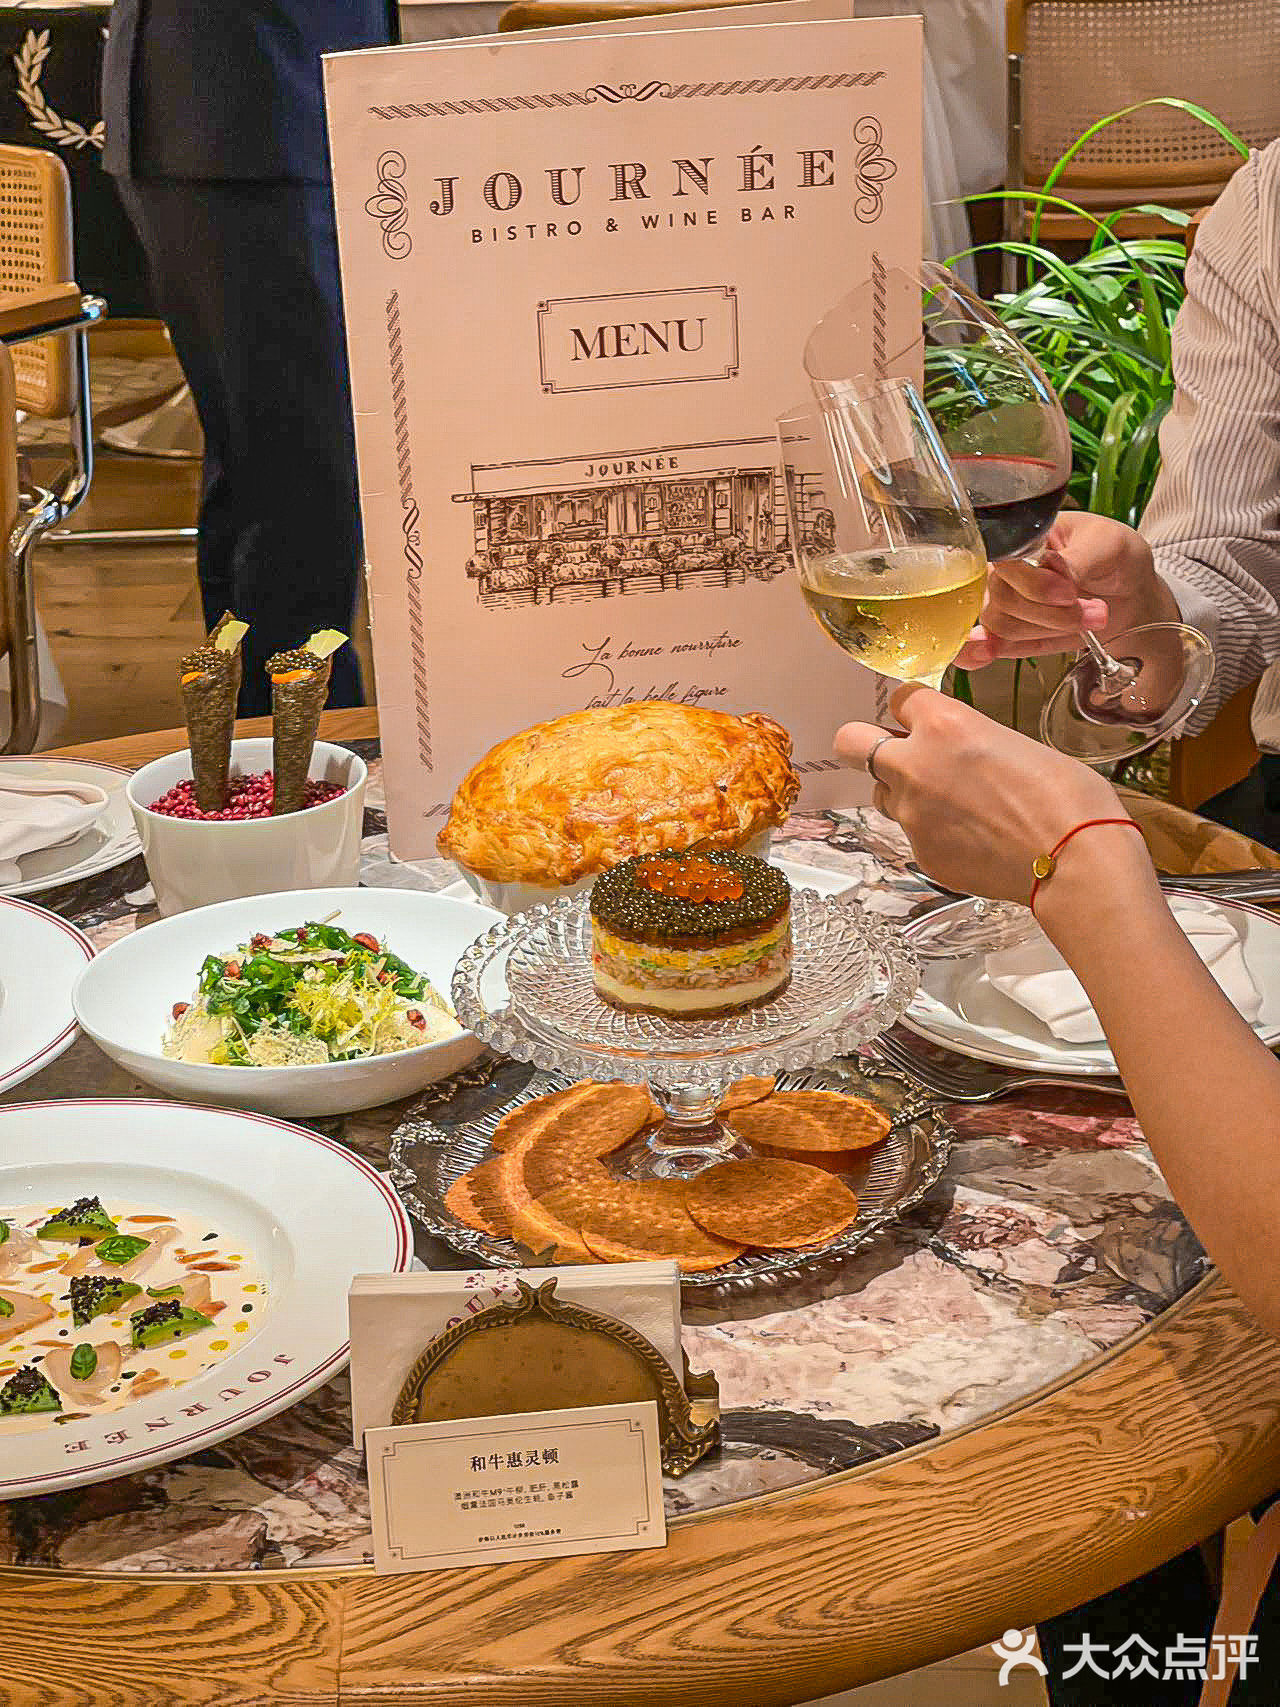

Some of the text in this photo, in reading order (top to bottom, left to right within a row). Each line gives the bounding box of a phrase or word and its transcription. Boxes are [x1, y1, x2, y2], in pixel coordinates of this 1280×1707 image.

[429, 144, 835, 216] JOURNÉE
[471, 205, 795, 244] BISTRO & WINE BAR
[569, 317, 708, 362] MENU
[584, 455, 680, 478] JOURNÉE
[616, 641, 663, 660] bonne
[470, 1447, 560, 1472] 和牛惠灵顿
